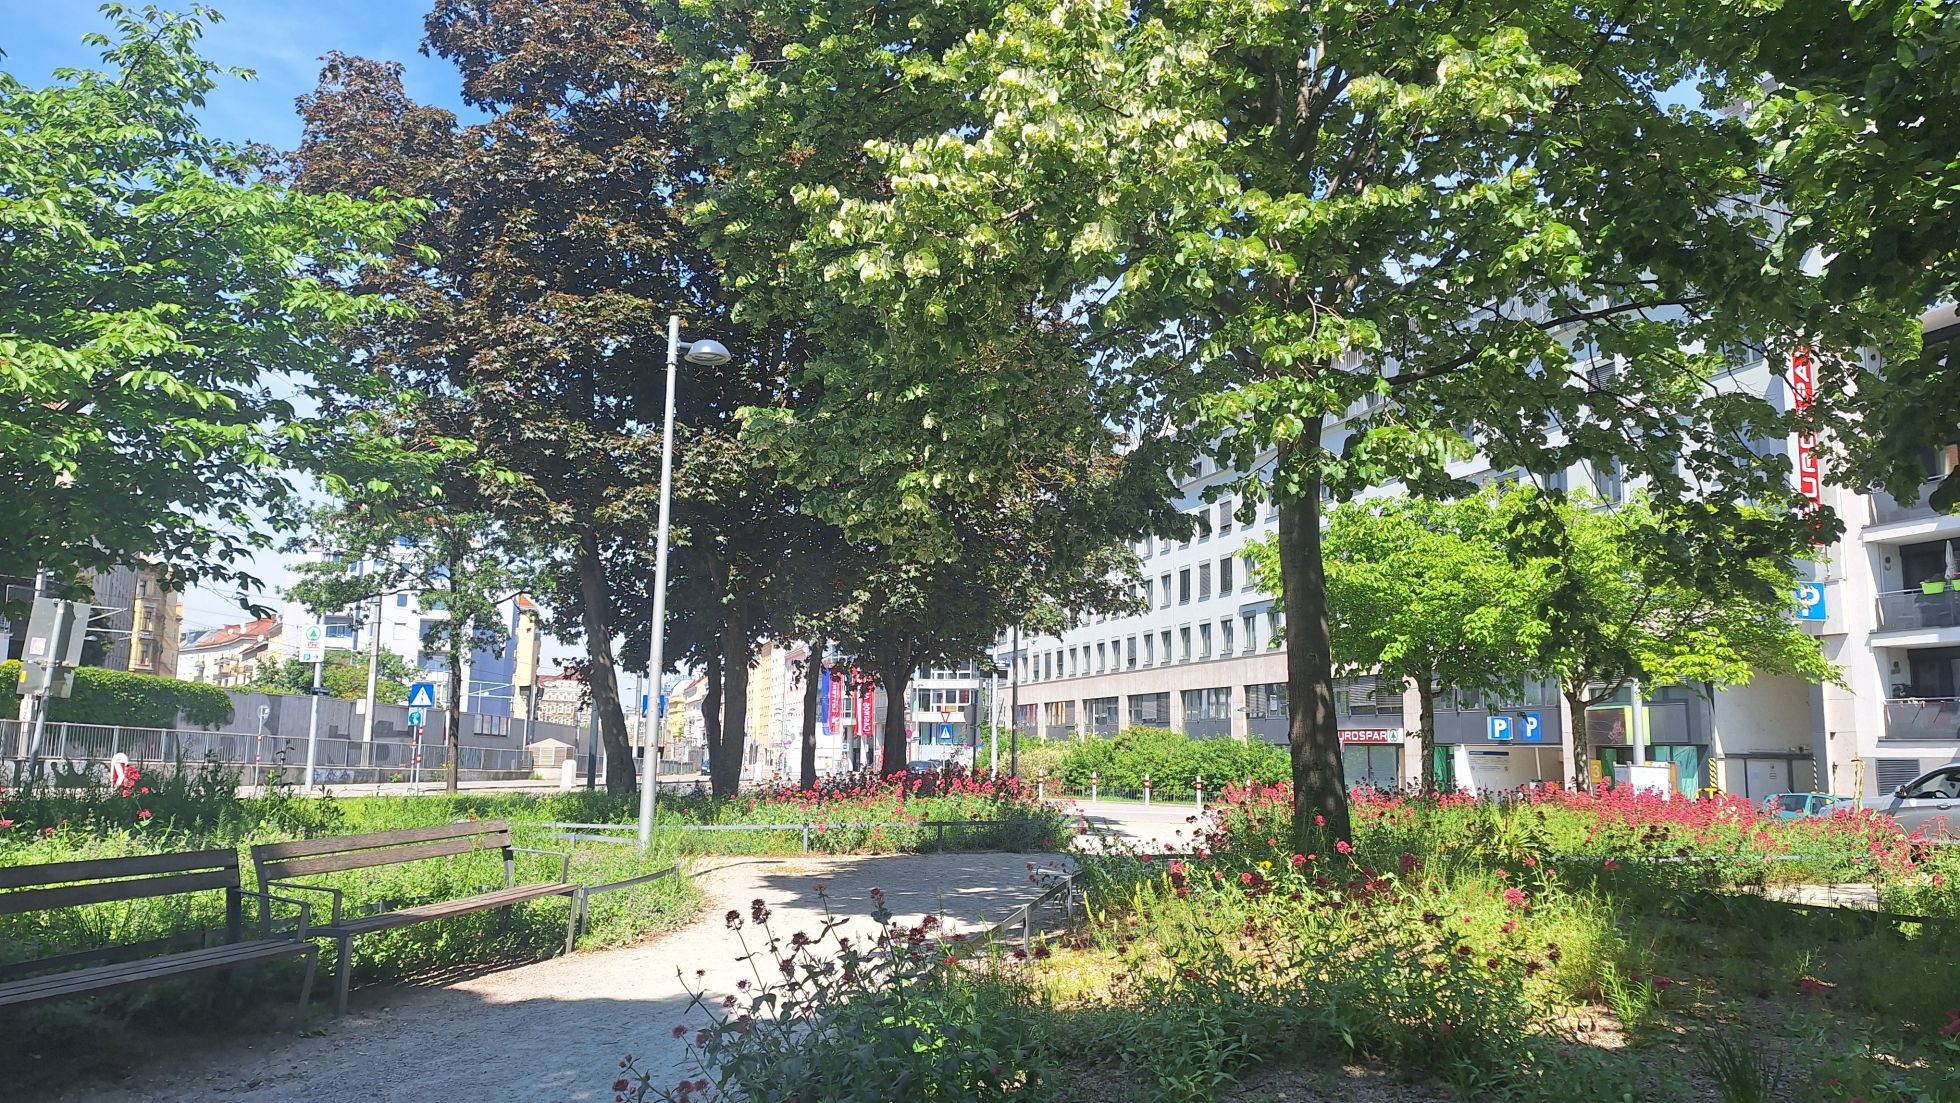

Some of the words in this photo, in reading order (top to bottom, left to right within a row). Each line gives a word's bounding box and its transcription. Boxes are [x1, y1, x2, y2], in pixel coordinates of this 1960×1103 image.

[1800, 586, 1820, 617] P
[1338, 730, 1387, 741] UROSPAR
[1494, 719, 1507, 737] P
[1526, 716, 1538, 737] P
[1593, 765, 1600, 778] 3
